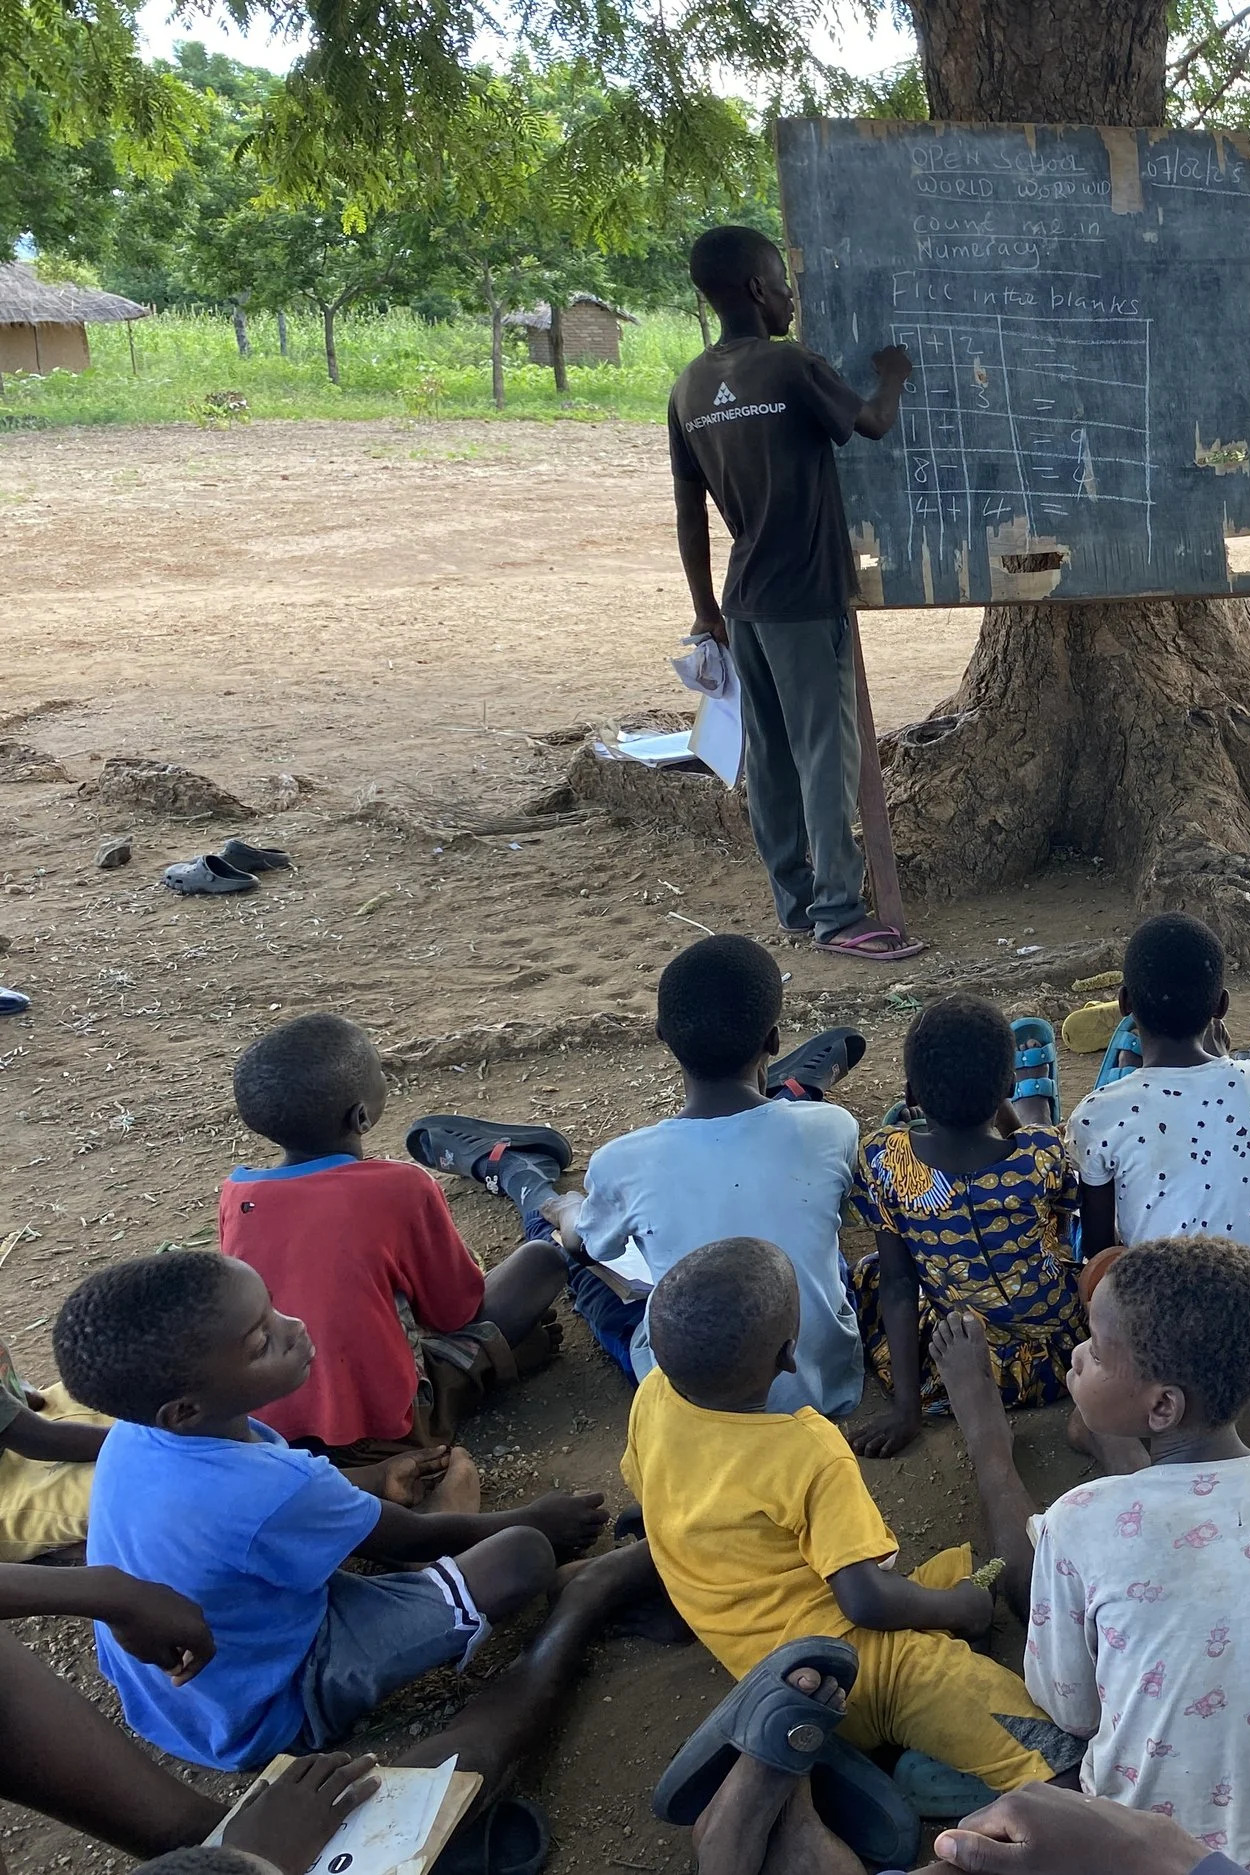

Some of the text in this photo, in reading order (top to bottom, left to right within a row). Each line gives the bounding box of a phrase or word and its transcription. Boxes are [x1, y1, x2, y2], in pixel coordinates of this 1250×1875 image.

[911, 145, 1085, 173] OPEN SCHOOL
[916, 177, 994, 197] WORLD
[1022, 218, 1066, 236] me
[1050, 286, 1141, 315] blanks
[959, 336, 985, 355] 2
[970, 384, 990, 409] 3
[685, 402, 787, 433] ONEPARTNERGROUP
[912, 455, 930, 483] 8
[915, 495, 938, 519] 4
[982, 496, 1012, 520] 4
